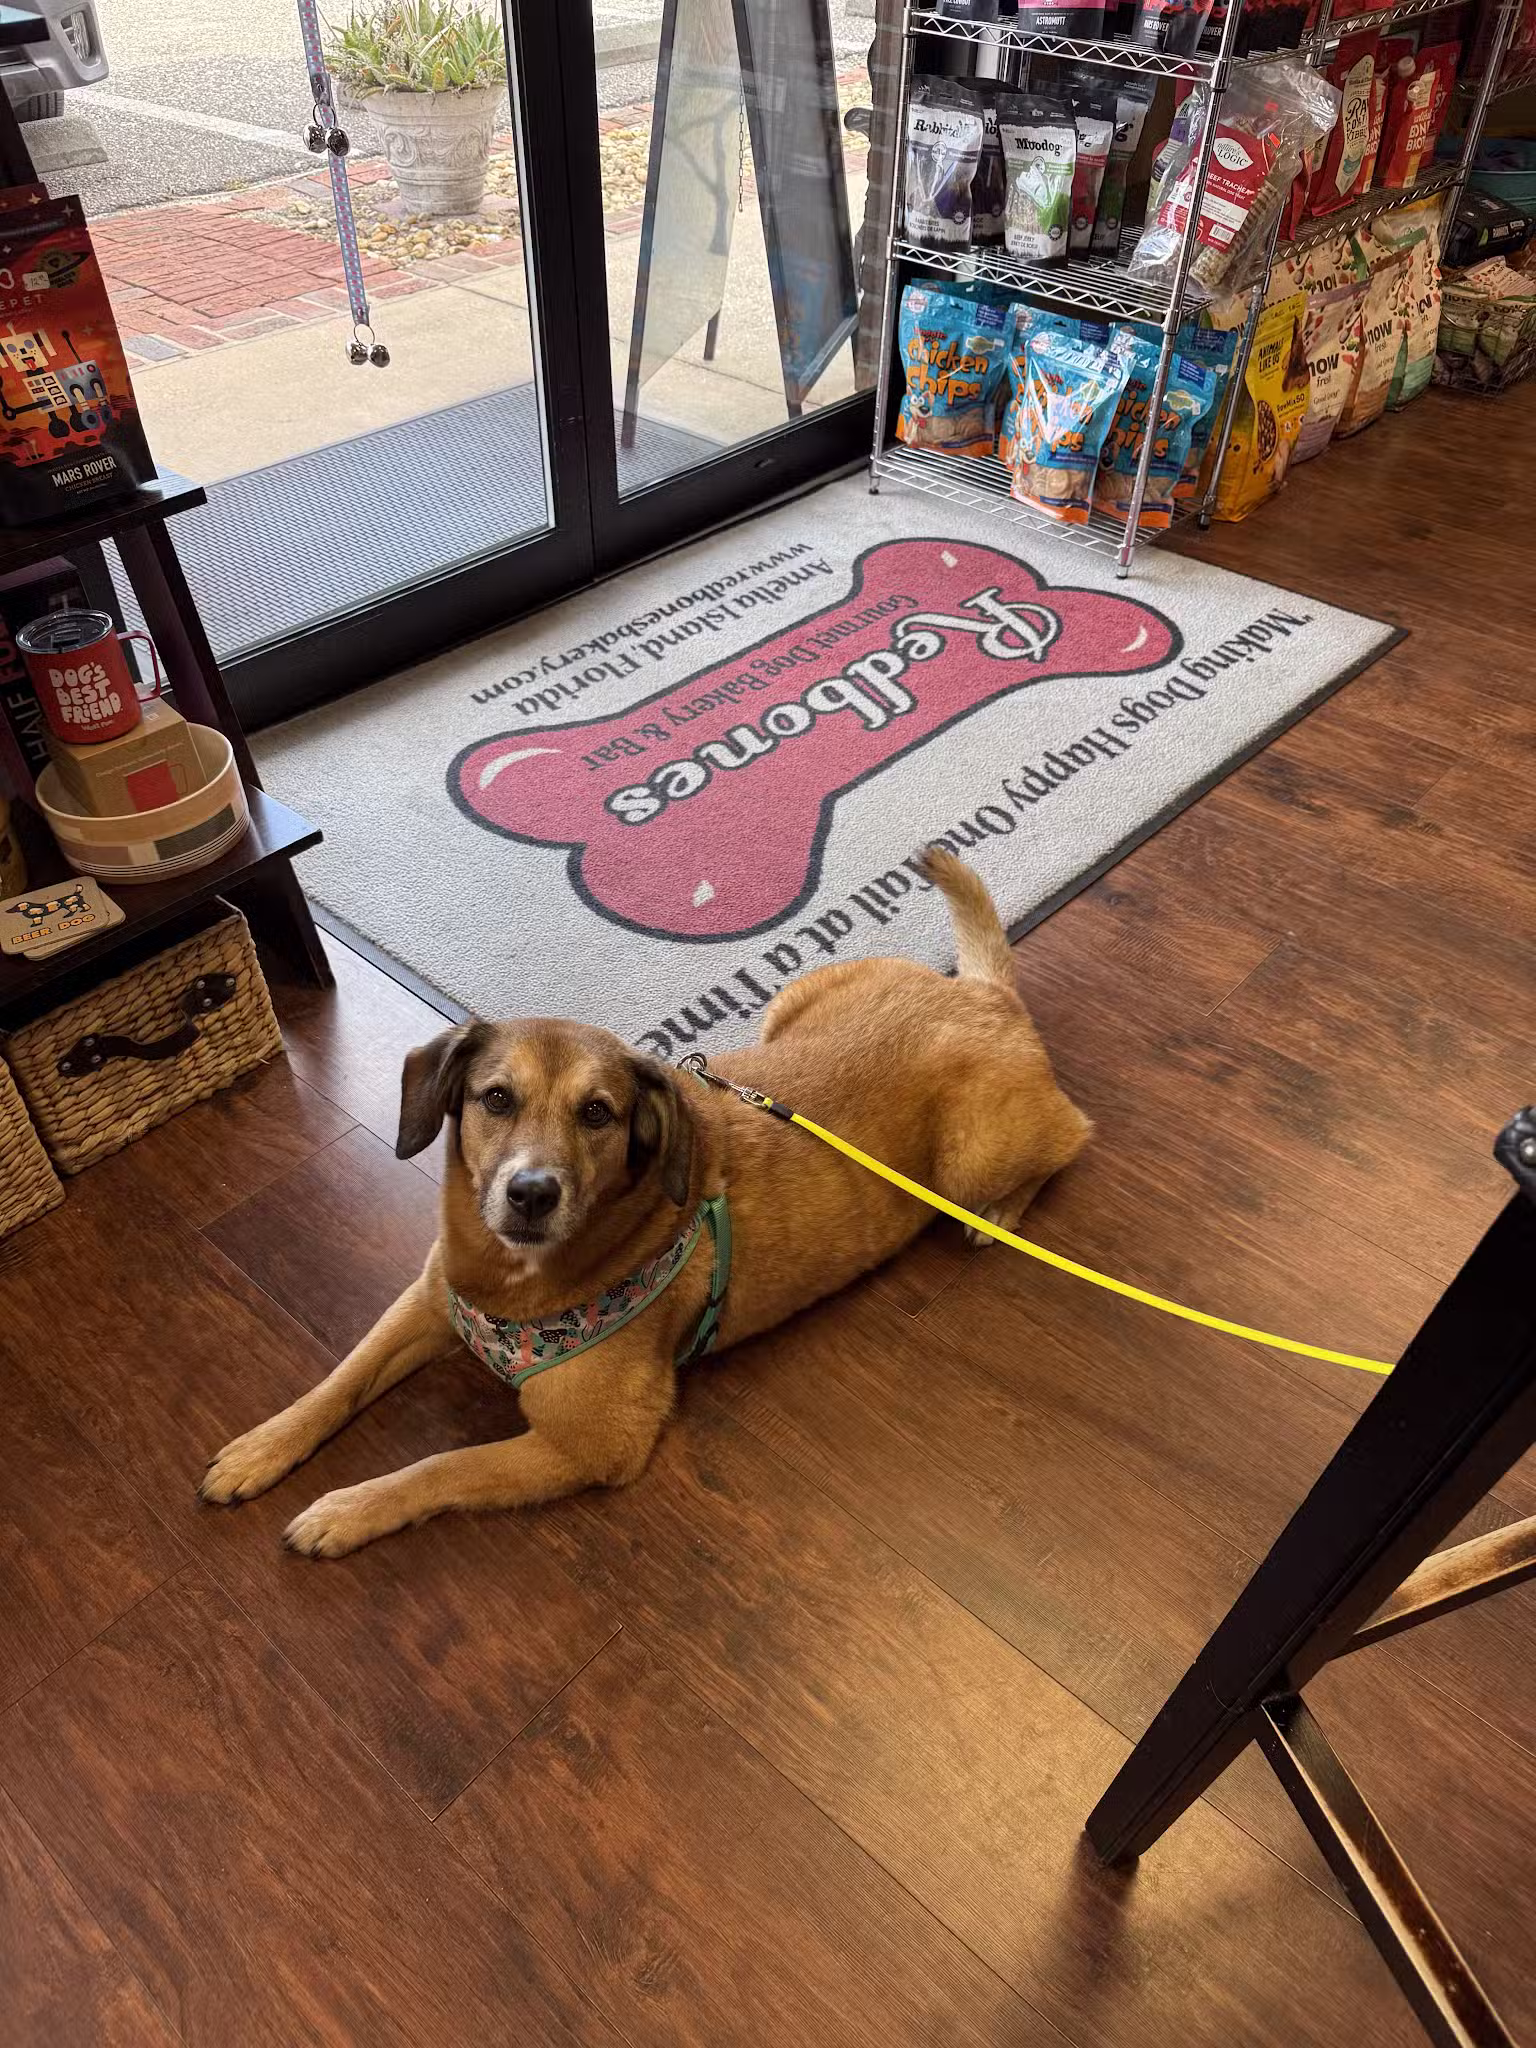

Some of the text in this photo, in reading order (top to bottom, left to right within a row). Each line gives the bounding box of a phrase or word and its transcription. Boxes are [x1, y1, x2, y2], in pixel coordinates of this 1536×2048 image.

[1345, 97, 1369, 122] RA
[1217, 149, 1248, 167] LOGIC
[1367, 319, 1393, 345] now
[907, 338, 989, 375] Chicken
[1308, 353, 1340, 378] now
[906, 363, 983, 407] Chips
[51, 466, 83, 488] MARS
[82, 455, 117, 478] ROVER
[721, 557, 834, 610] Amelia
[470, 542, 813, 705] www.redbonesbakery.com
[49, 662, 107, 688] DOG'S
[56, 678, 111, 706] BEST
[511, 652, 644, 717] Florida
[581, 594, 920, 771] Gourmet Dog Bakery & Bar
[605, 587, 1063, 826] Redbones
[1110, 673, 1208, 735] Dogs
[1000, 725, 1133, 814] Happy
[11, 913, 96, 945] BEER DOG
[794, 908, 854, 955] at
[762, 942, 802, 976] a
